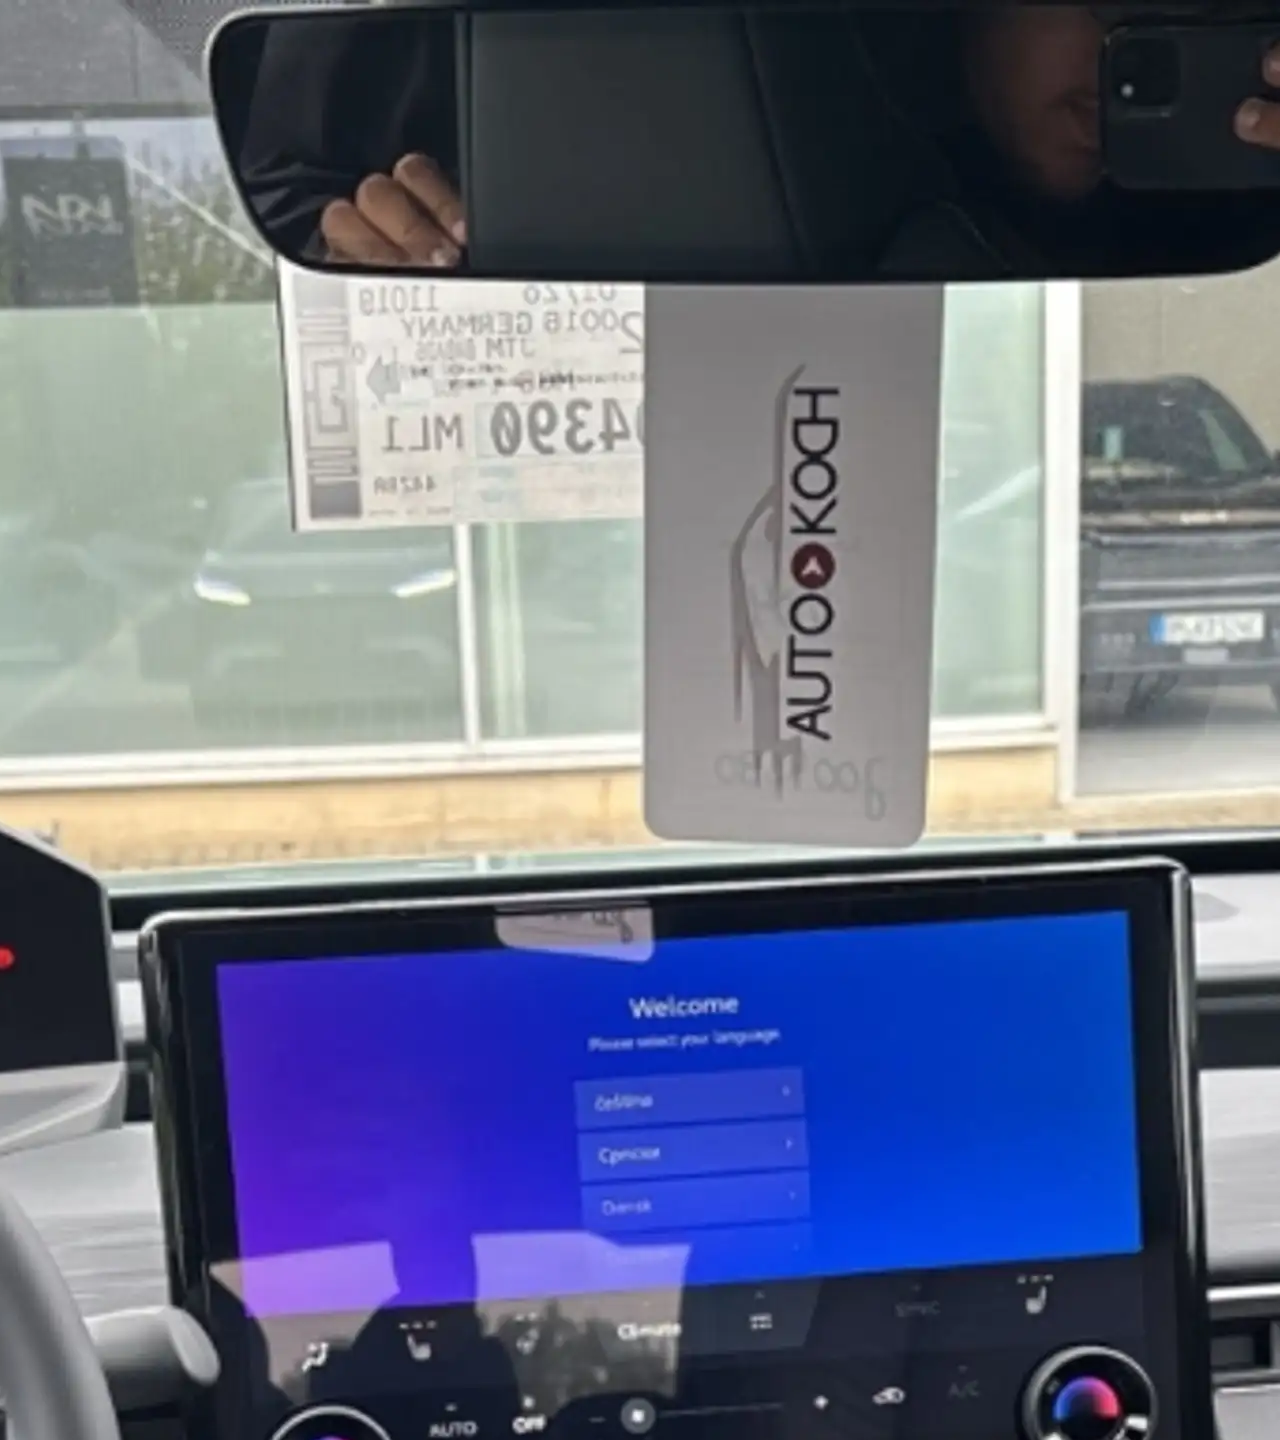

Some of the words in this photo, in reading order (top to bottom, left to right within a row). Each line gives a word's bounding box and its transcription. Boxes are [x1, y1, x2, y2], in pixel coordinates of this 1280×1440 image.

[629, 994, 739, 1019] Welcome
[588, 1037, 634, 1052] Please
[637, 1034, 677, 1049] select
[681, 1033, 708, 1050] your
[428, 1421, 479, 1438] AUTO
[512, 1415, 546, 1434] OFF
